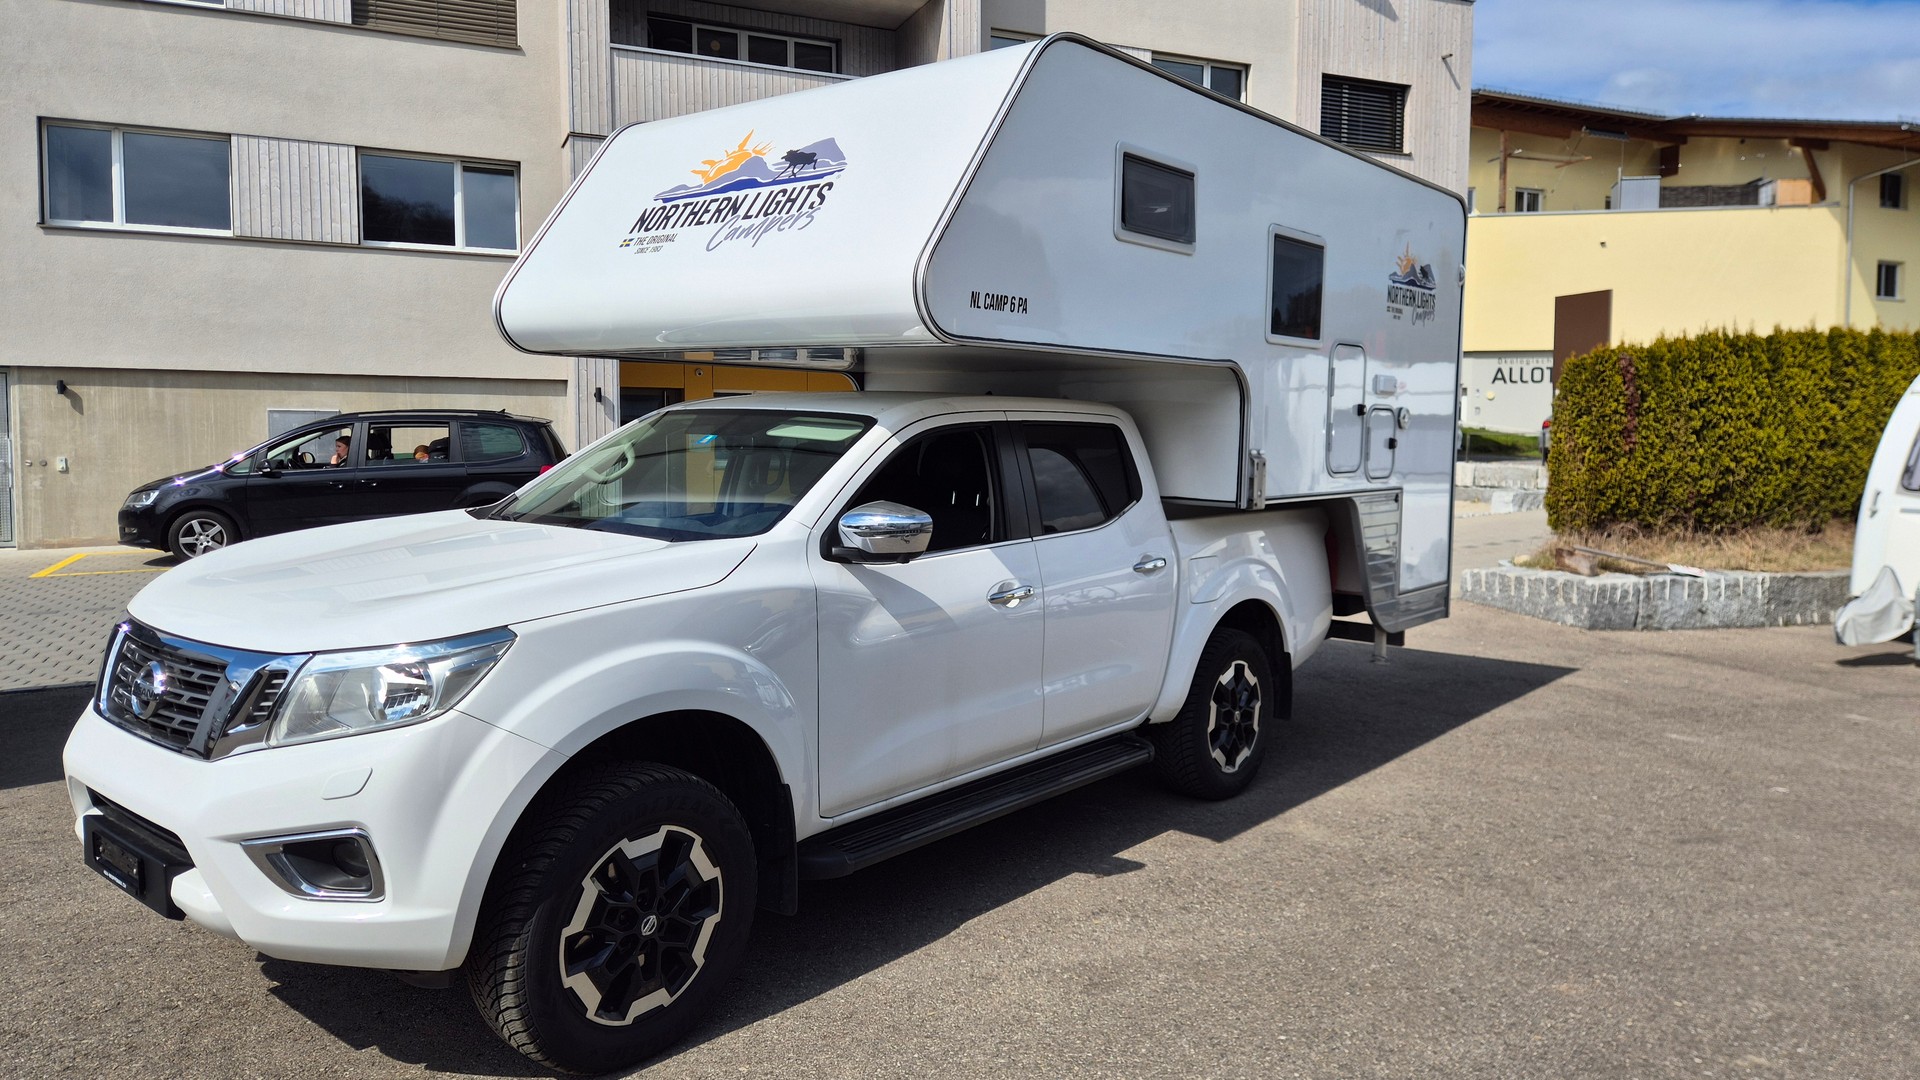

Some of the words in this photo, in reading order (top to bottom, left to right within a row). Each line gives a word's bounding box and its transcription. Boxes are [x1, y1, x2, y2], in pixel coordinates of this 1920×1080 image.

[629, 195, 741, 235] NORTHERN
[741, 181, 834, 221] LIGHTS
[633, 236, 649, 246] THE
[647, 233, 678, 245] ORIGINAL
[706, 207, 821, 252] Campers
[970, 290, 981, 309] NL
[983, 292, 1009, 312] CAMP
[1009, 296, 1016, 313] 6
[1017, 296, 1028, 314] PA
[1387, 285, 1416, 307] NORTHERN
[1416, 290, 1436, 310] LIGHTS
